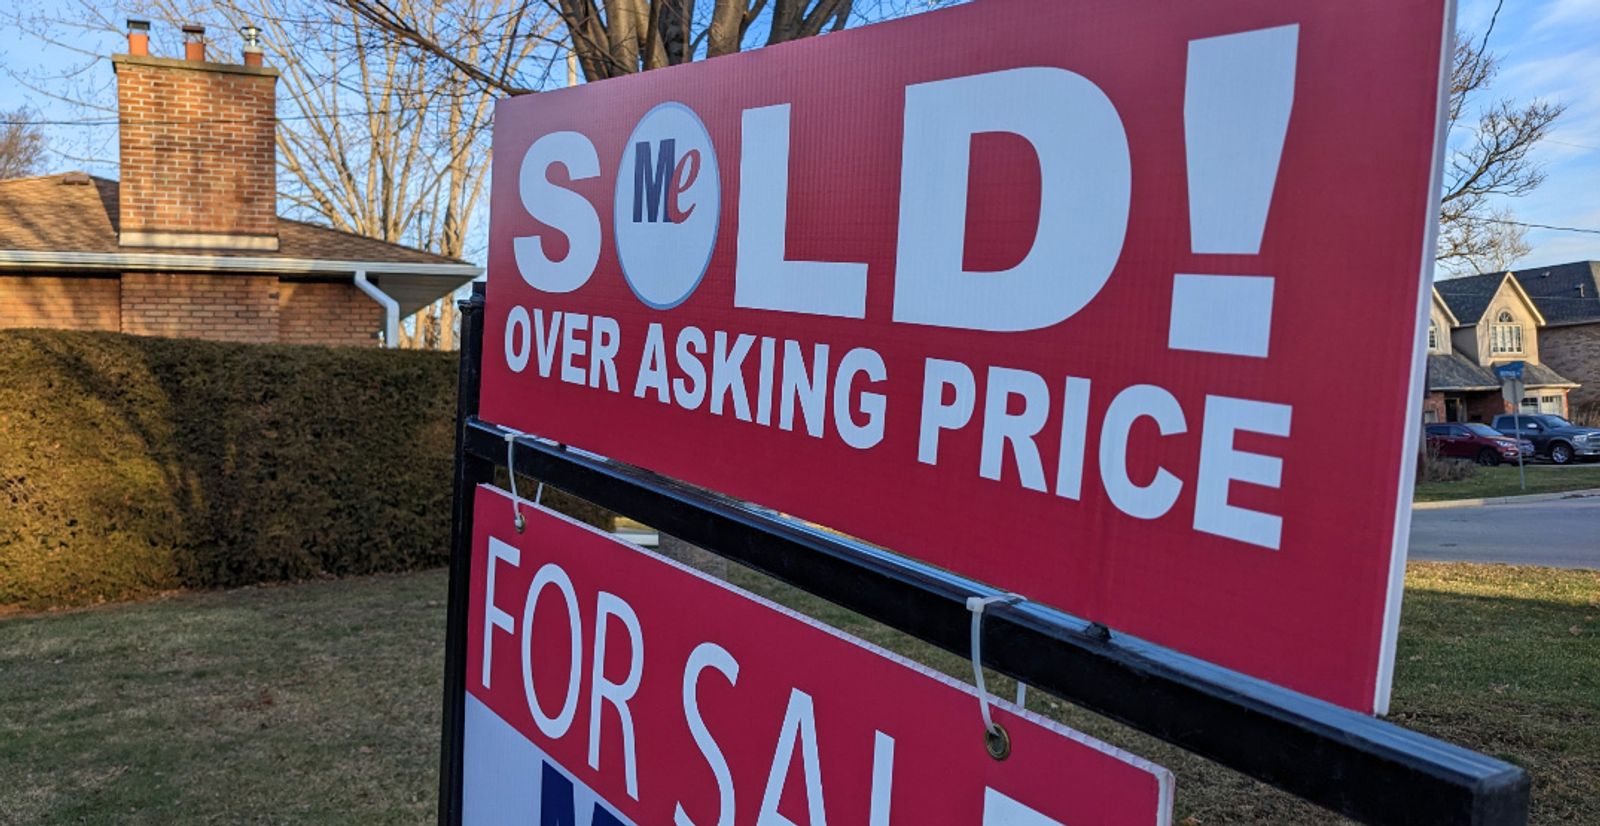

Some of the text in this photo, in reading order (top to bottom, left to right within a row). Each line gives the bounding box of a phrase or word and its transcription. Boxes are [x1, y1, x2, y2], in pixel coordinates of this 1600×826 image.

[633, 139, 701, 224] Me
[505, 305, 1293, 550] OVER ASKING PRICE
[482, 537, 1067, 826] FOR SA
